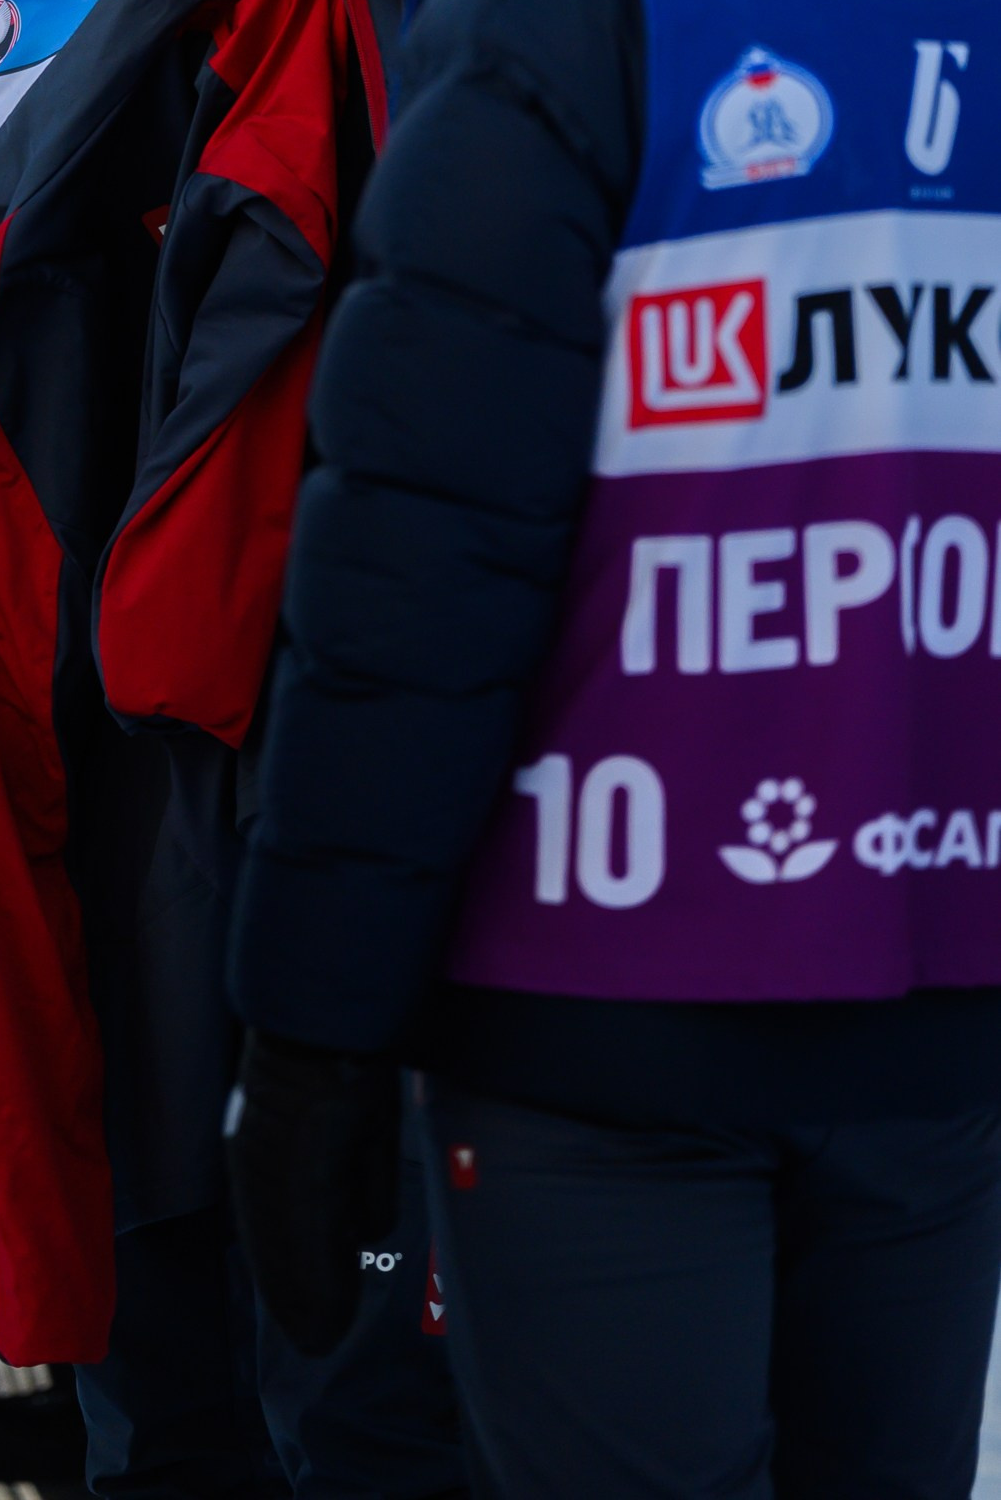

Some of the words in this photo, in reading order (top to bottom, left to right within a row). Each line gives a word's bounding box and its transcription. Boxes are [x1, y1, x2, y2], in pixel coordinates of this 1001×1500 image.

[775, 281, 1001, 393] ЛУК
[621, 514, 1001, 676] ПЕРО
[513, 753, 666, 911] 10
